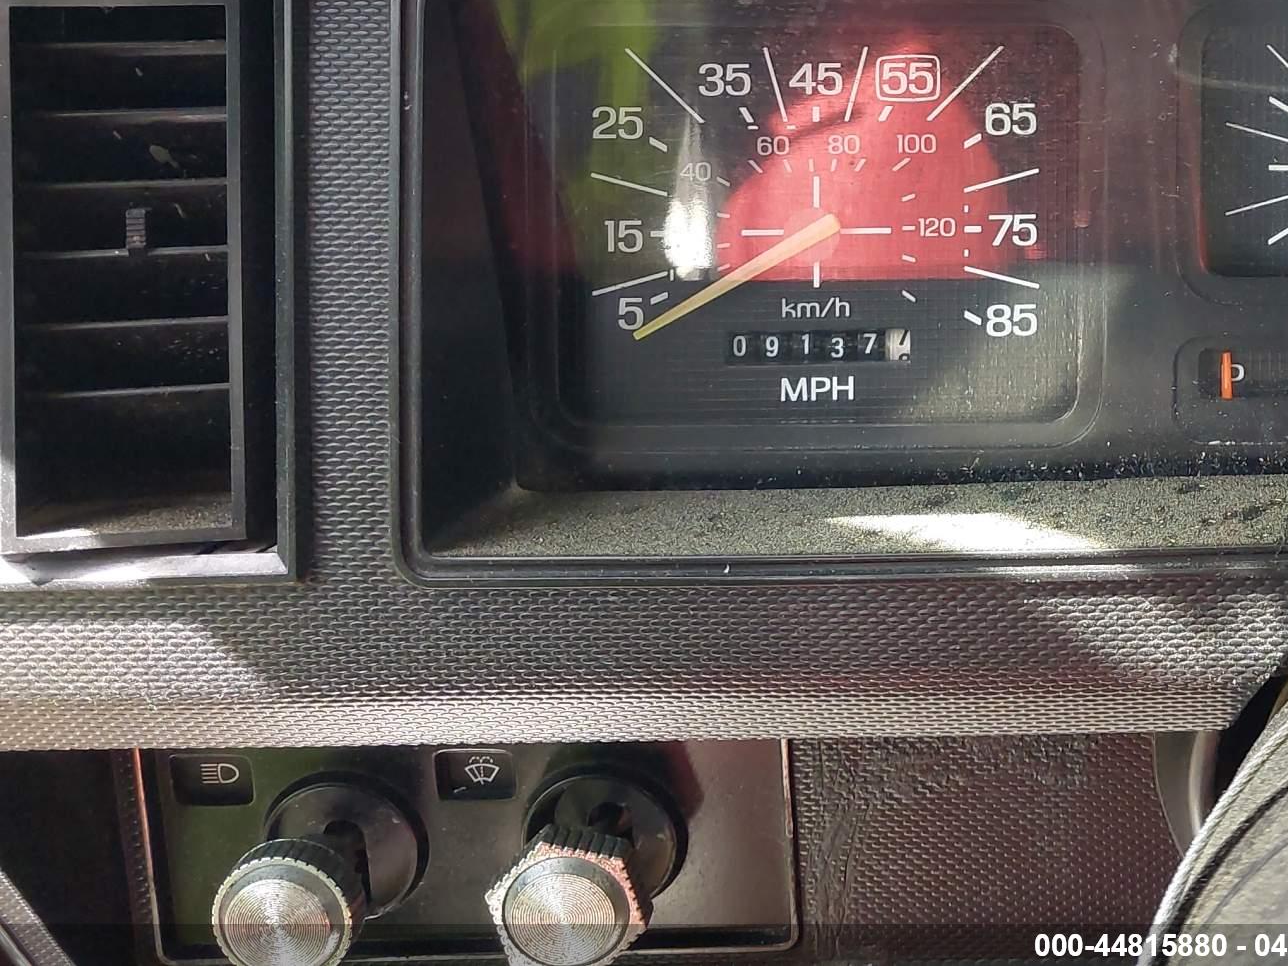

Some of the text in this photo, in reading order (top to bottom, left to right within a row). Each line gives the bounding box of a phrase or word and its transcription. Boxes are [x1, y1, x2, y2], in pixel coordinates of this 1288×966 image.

[698, 63, 751, 96] 35
[789, 63, 842, 95] 45
[881, 62, 934, 94] 55
[591, 106, 643, 139] 25
[985, 103, 1037, 135] 65
[757, 136, 789, 155] 60
[828, 135, 860, 155] 80
[897, 135, 936, 153] 100
[680, 162, 711, 181] 40
[604, 220, 643, 252] 15
[918, 218, 956, 237] 120
[988, 214, 1037, 246] 75
[617, 297, 645, 330] 5
[781, 298, 850, 319] km/h
[986, 305, 1037, 336] 85
[780, 377, 855, 402] MPH
